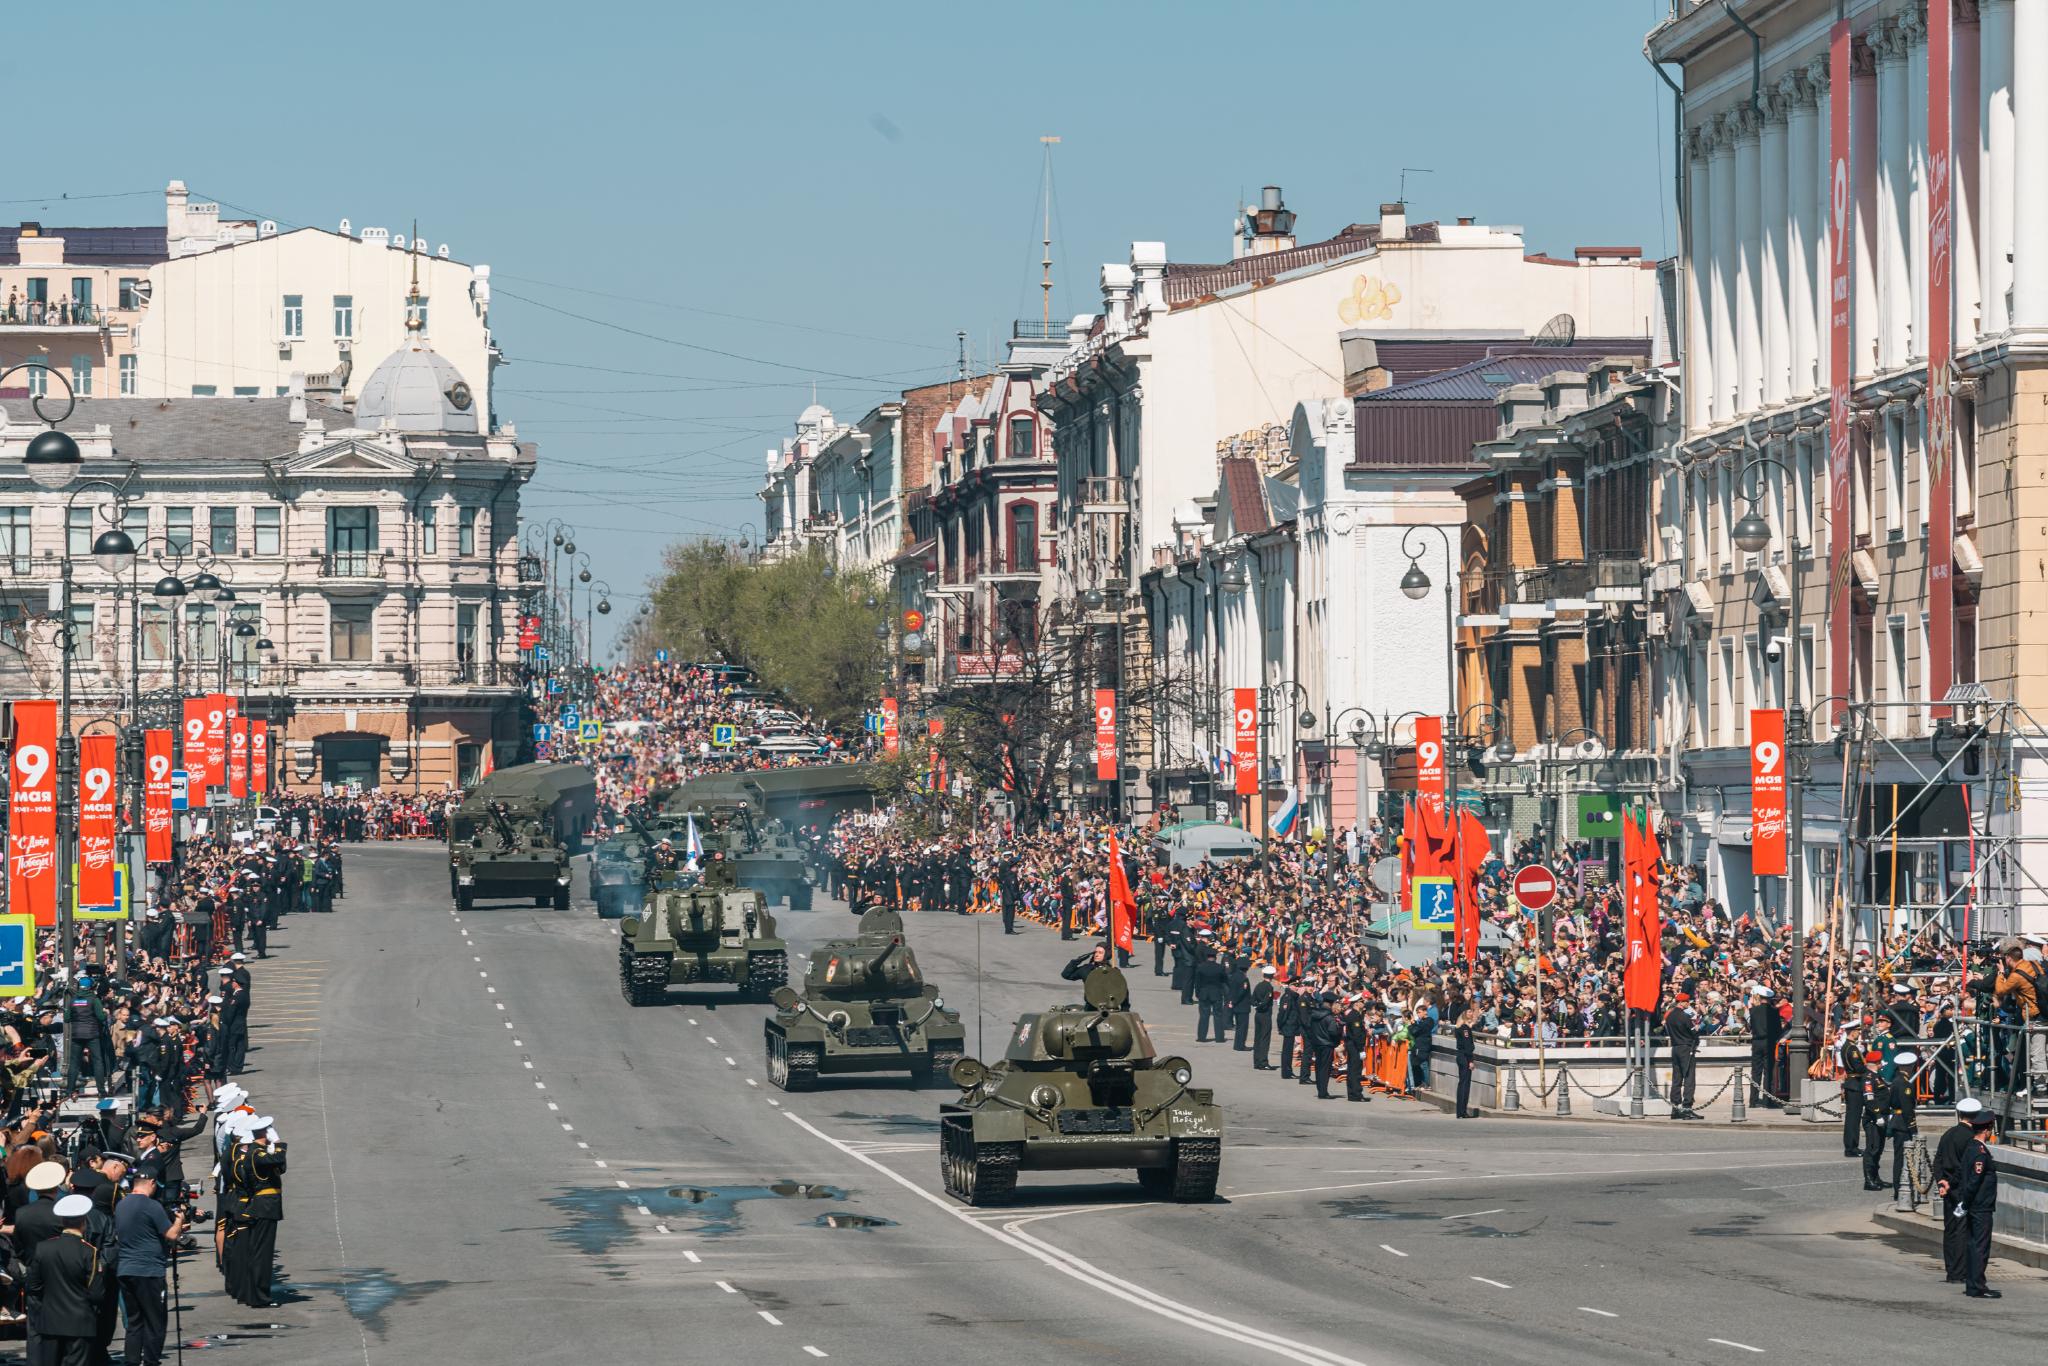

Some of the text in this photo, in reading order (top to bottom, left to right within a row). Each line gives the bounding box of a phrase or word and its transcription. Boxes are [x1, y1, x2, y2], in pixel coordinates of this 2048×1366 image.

[1834, 157, 1847, 265] 9
[209, 710, 223, 729] 9
[1099, 706, 1113, 725] 9
[1237, 708, 1254, 730] 9
[187, 719, 204, 741] 9
[233, 732, 246, 748] 9
[254, 734, 265, 748] 9
[1419, 741, 1439, 767] 9
[1755, 741, 1780, 773] 9
[16, 744, 50, 788] 9
[149, 754, 169, 781] 9
[85, 767, 111, 801] 9
[1755, 776, 1782, 784] мая
[14, 791, 52, 803] мая
[83, 803, 112, 812] мая
